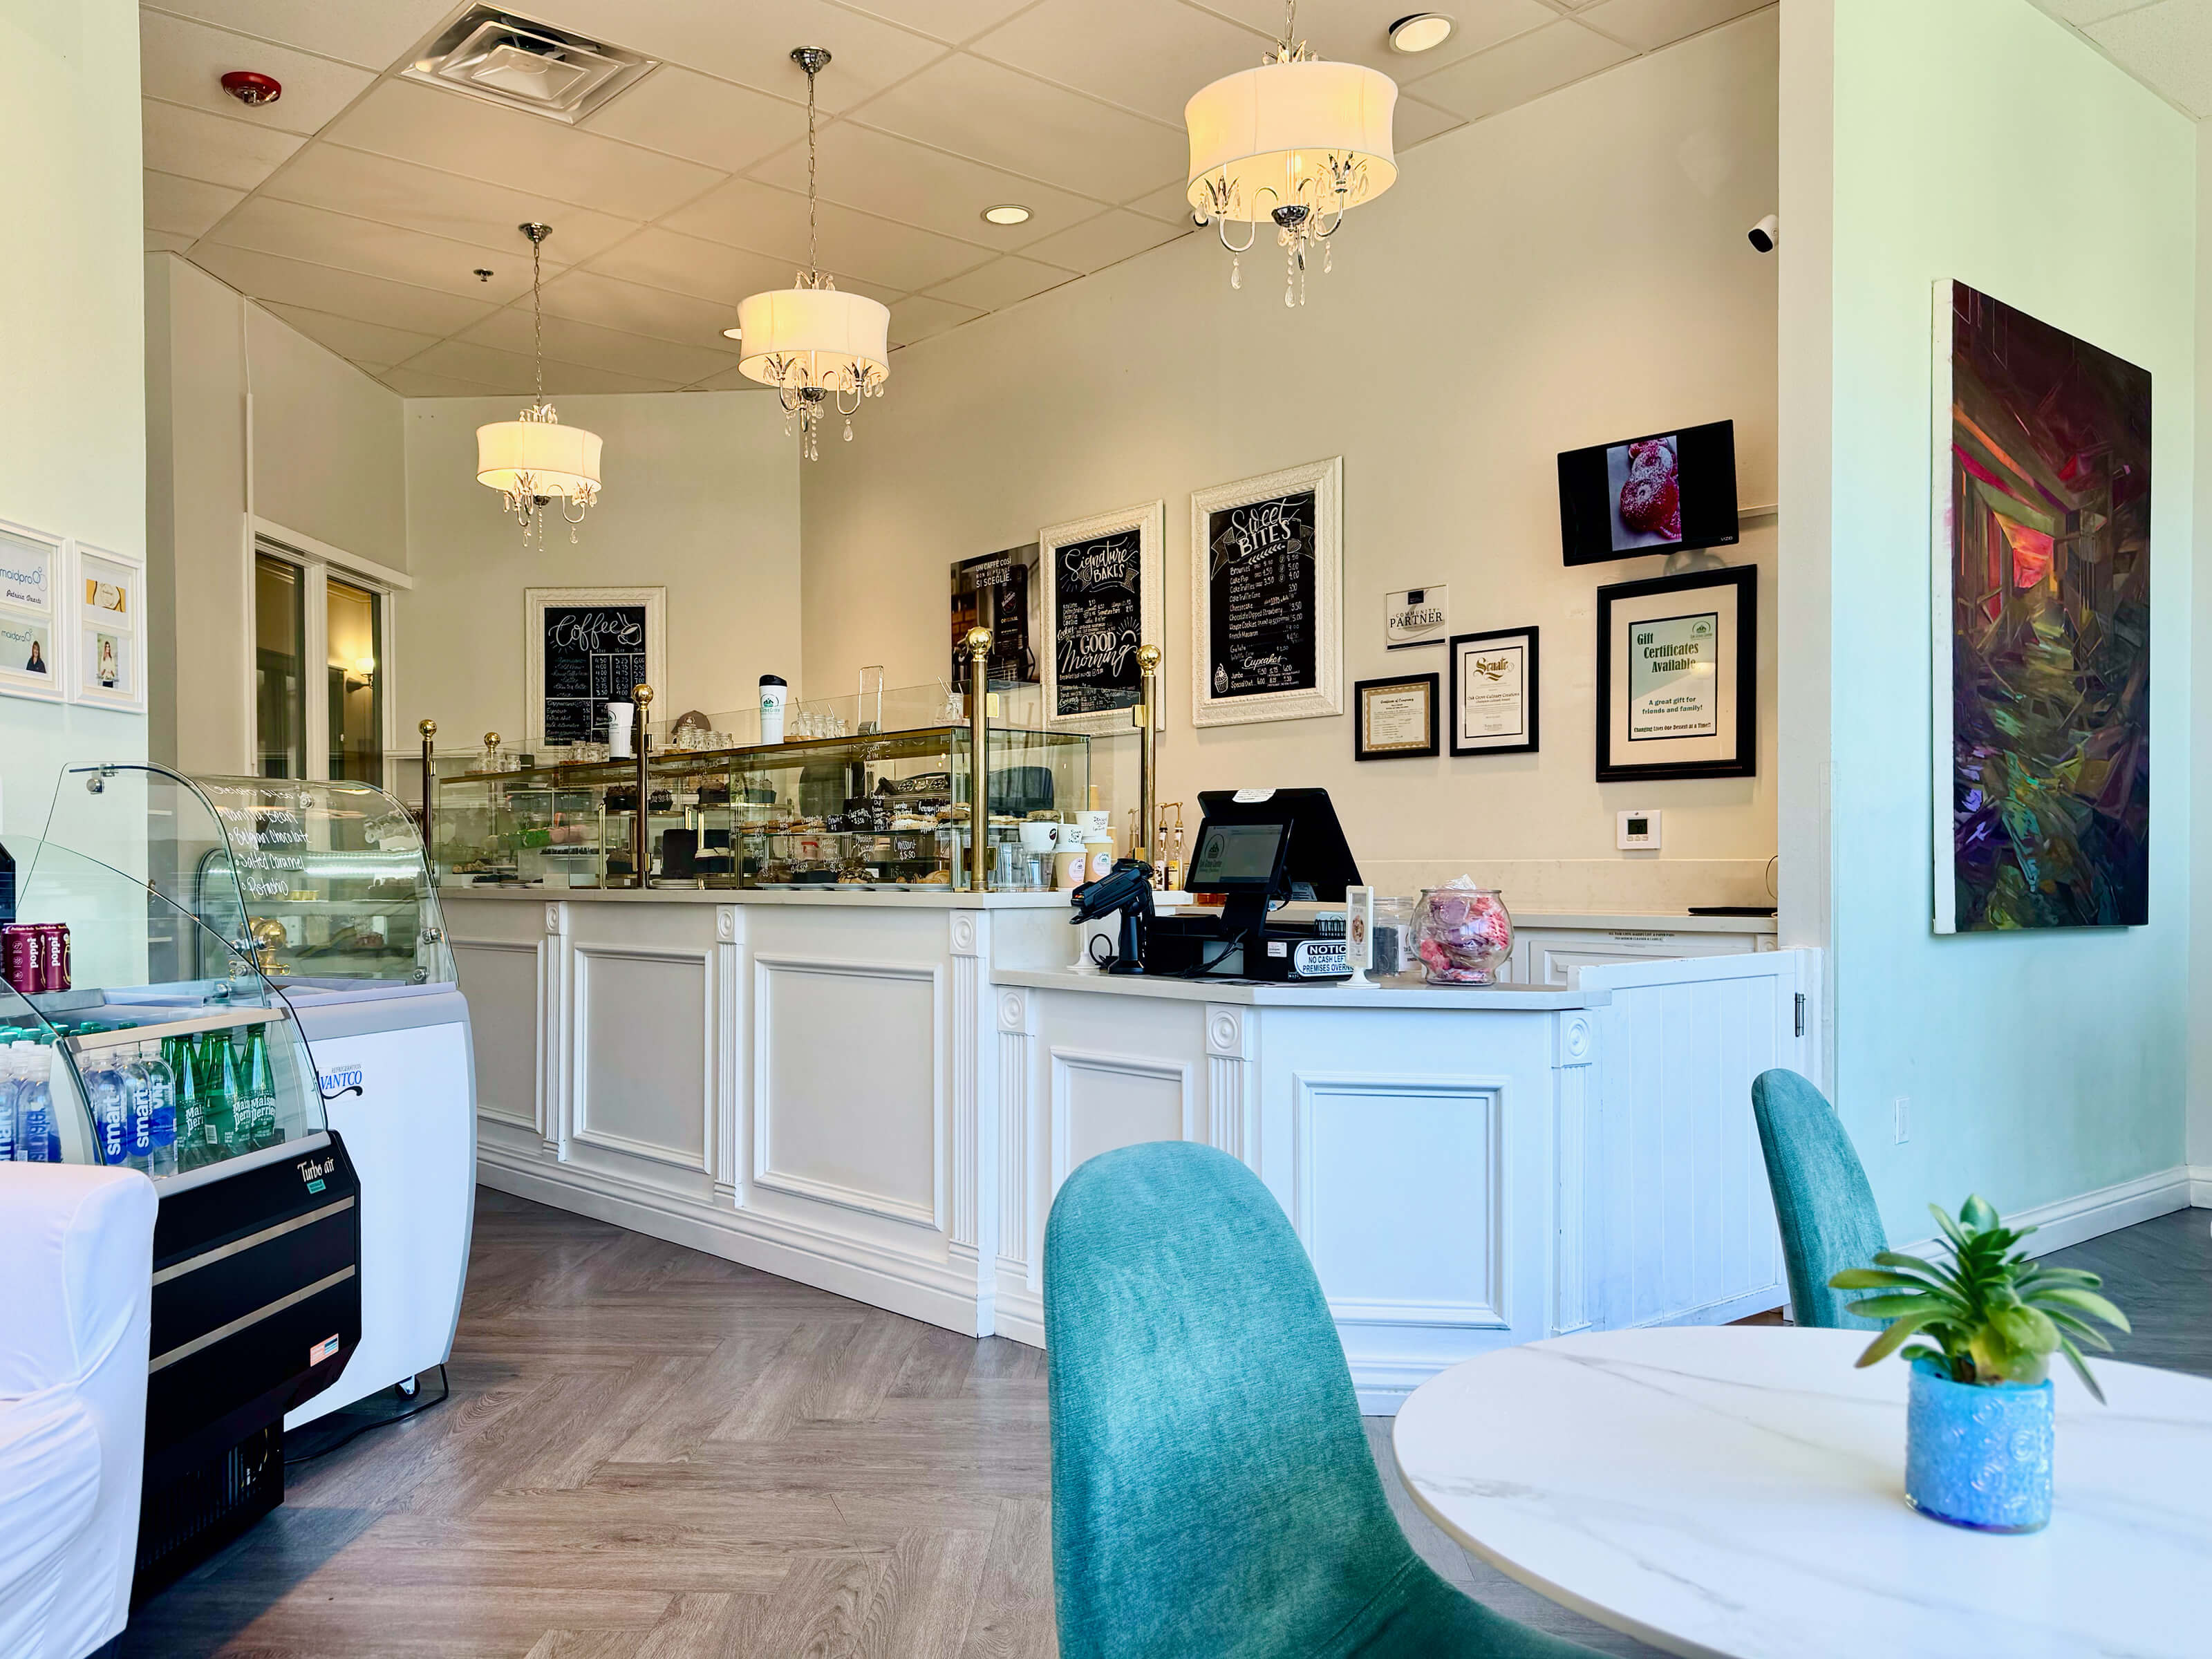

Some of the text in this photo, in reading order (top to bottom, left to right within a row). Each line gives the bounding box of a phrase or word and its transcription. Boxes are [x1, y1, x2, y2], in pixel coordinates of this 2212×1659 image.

[1232, 498, 1308, 541] Sweet
[1238, 519, 1293, 557] BITES
[1065, 538, 1138, 581] Signature
[976, 573, 1012, 588] SI SCEGLIE.
[1094, 563, 1125, 582] BAKES
[1390, 612, 1443, 628] PARTNER
[1395, 608, 1436, 618] COMMUNITY
[549, 612, 624, 651] Coffee
[1637, 632, 1653, 645] Gift
[1080, 632, 1116, 655] GOOD
[1644, 643, 1698, 659] Certificates
[1058, 641, 1138, 677] Morning
[1244, 653, 1282, 670] Cupcakes
[1473, 656, 1514, 677] Senate
[1654, 698, 1672, 706] great
[1673, 697, 1685, 705] gift
[226, 807, 299, 825] Vanilla Bean
[234, 827, 312, 850] Belgian Chocolate
[238, 852, 305, 870] Salted Caramel
[247, 877, 289, 898] Pistachio
[27, 937, 39, 968] poppi
[48, 936, 61, 967] poppi
[1310, 945, 1347, 954] NOTIC
[1303, 964, 1331, 973] PREMISES
[320, 1071, 362, 1089] VANTCO
[185, 1105, 205, 1120] Mai
[233, 1099, 250, 1114] Mais
[106, 1094, 121, 1156] smart
[136, 1089, 149, 1148] smart
[297, 1156, 335, 1183] Turbo air
